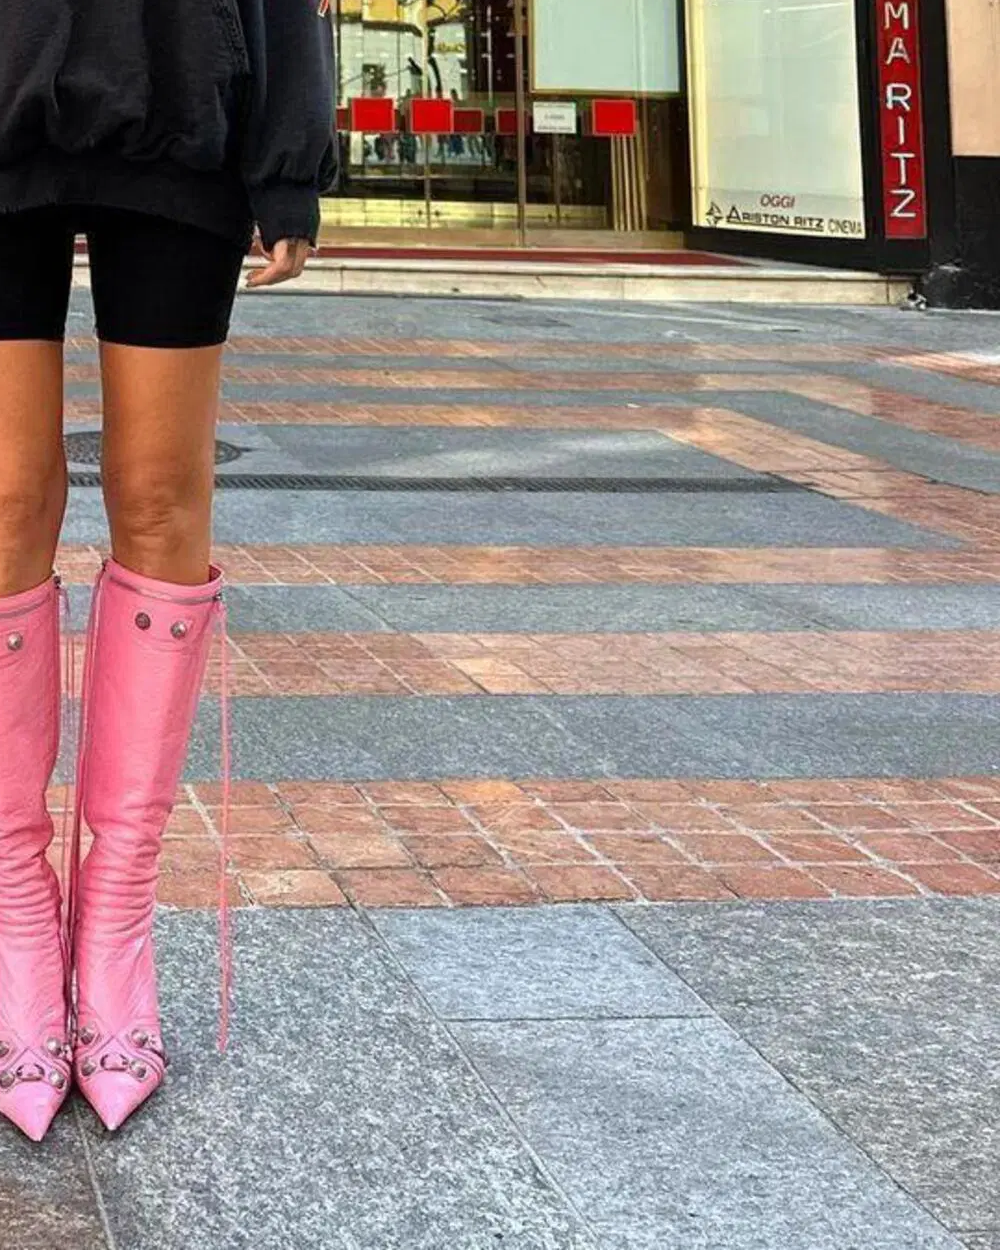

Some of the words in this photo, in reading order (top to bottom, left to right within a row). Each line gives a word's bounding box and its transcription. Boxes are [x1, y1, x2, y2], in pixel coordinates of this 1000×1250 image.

[885, 82, 917, 218] RITZ
[760, 194, 796, 208] OGGI
[726, 205, 789, 226] ARISTON
[794, 216, 824, 230] RITZ
[828, 219, 862, 234] CINEMA
